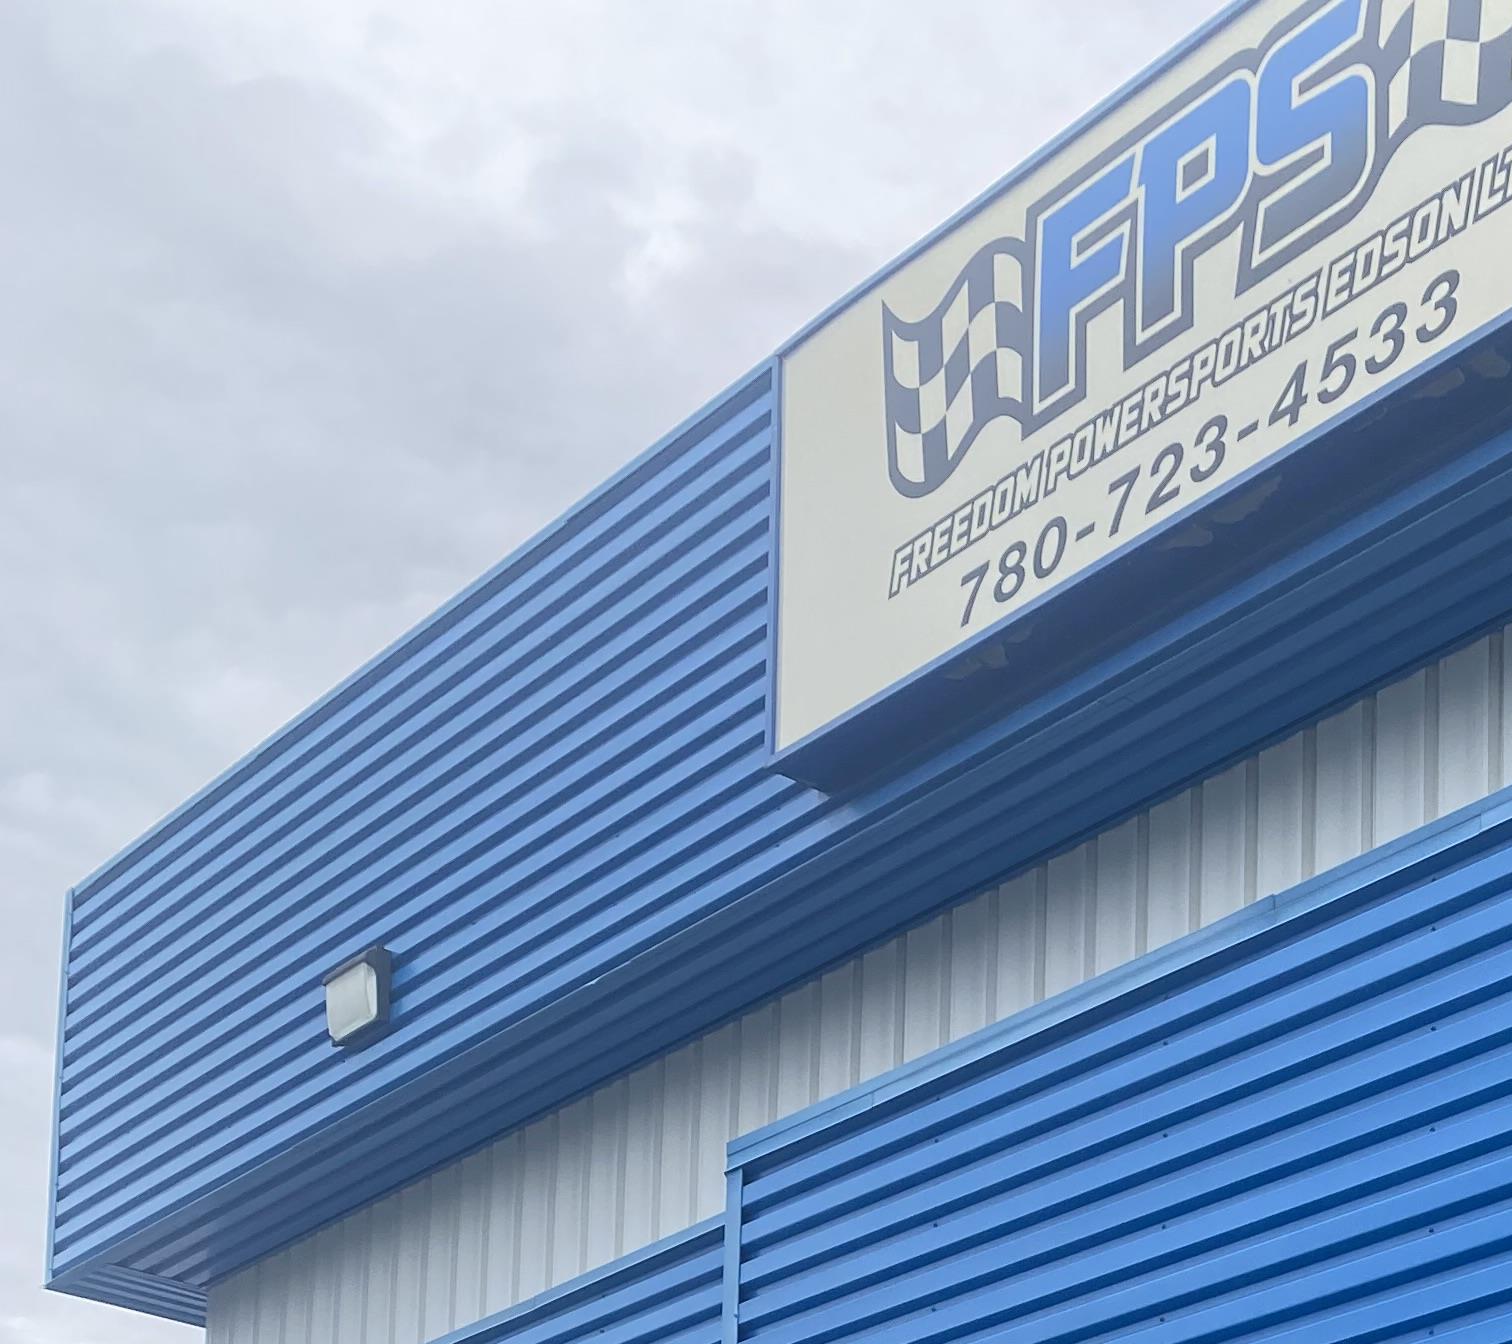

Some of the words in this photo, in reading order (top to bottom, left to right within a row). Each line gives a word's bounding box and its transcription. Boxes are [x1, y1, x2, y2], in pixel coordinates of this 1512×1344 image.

[889, 449, 1046, 600] FREEDOM
[1043, 266, 1324, 498] POWERSPORTS
[1321, 167, 1477, 320] EDSON
[1027, 0, 1380, 422] FPS
[961, 269, 1460, 628] 780-723-4533
